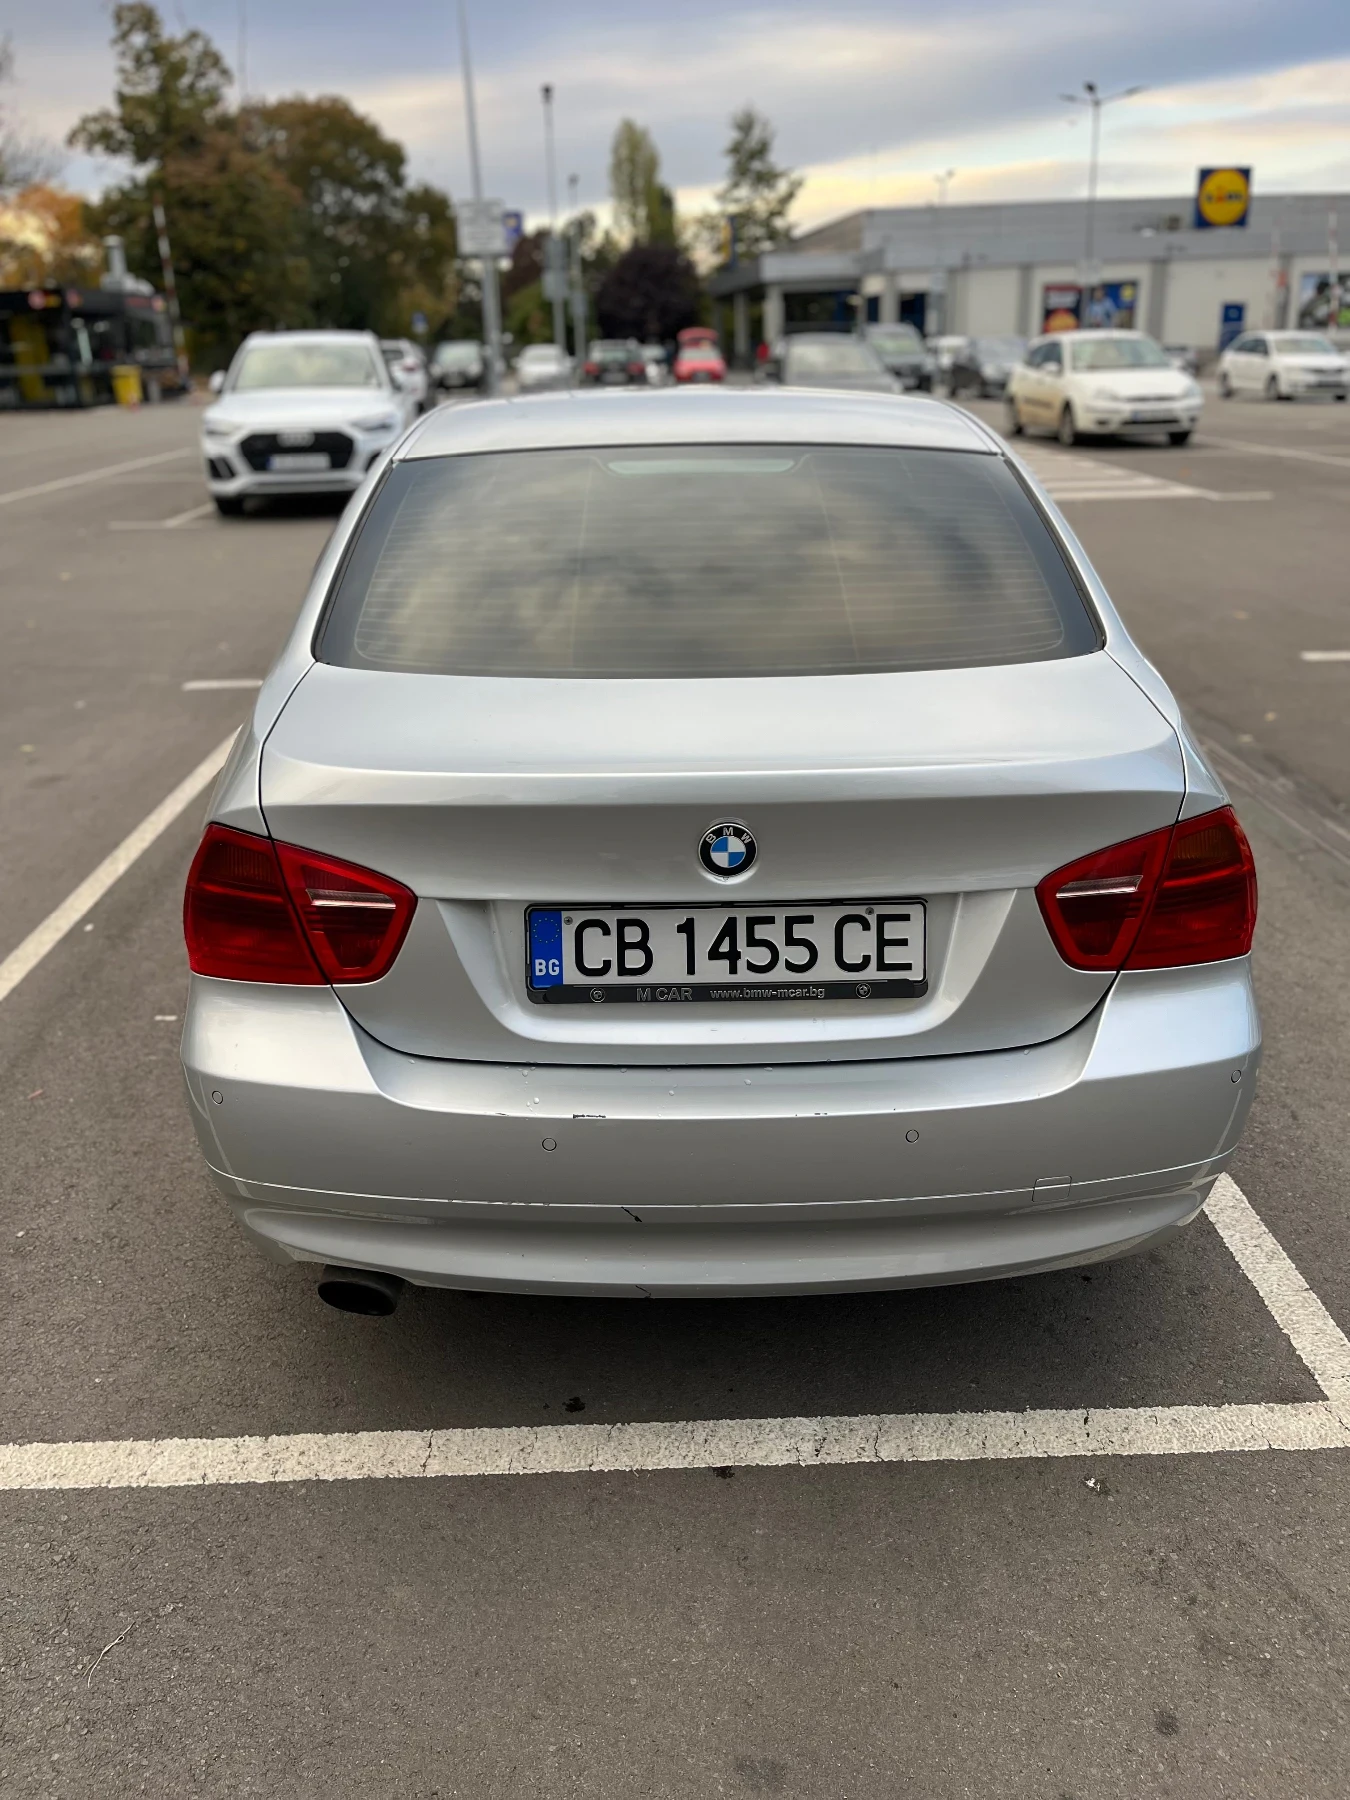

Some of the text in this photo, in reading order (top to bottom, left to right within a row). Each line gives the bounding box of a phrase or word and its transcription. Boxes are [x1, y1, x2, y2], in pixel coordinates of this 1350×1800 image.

[706, 827, 752, 844] BMW
[574, 913, 912, 977] CB 1455 CE
[536, 958, 560, 976] BG
[636, 987, 693, 1002] M CAR
[710, 985, 825, 999] www.bmw-mcar.bg
